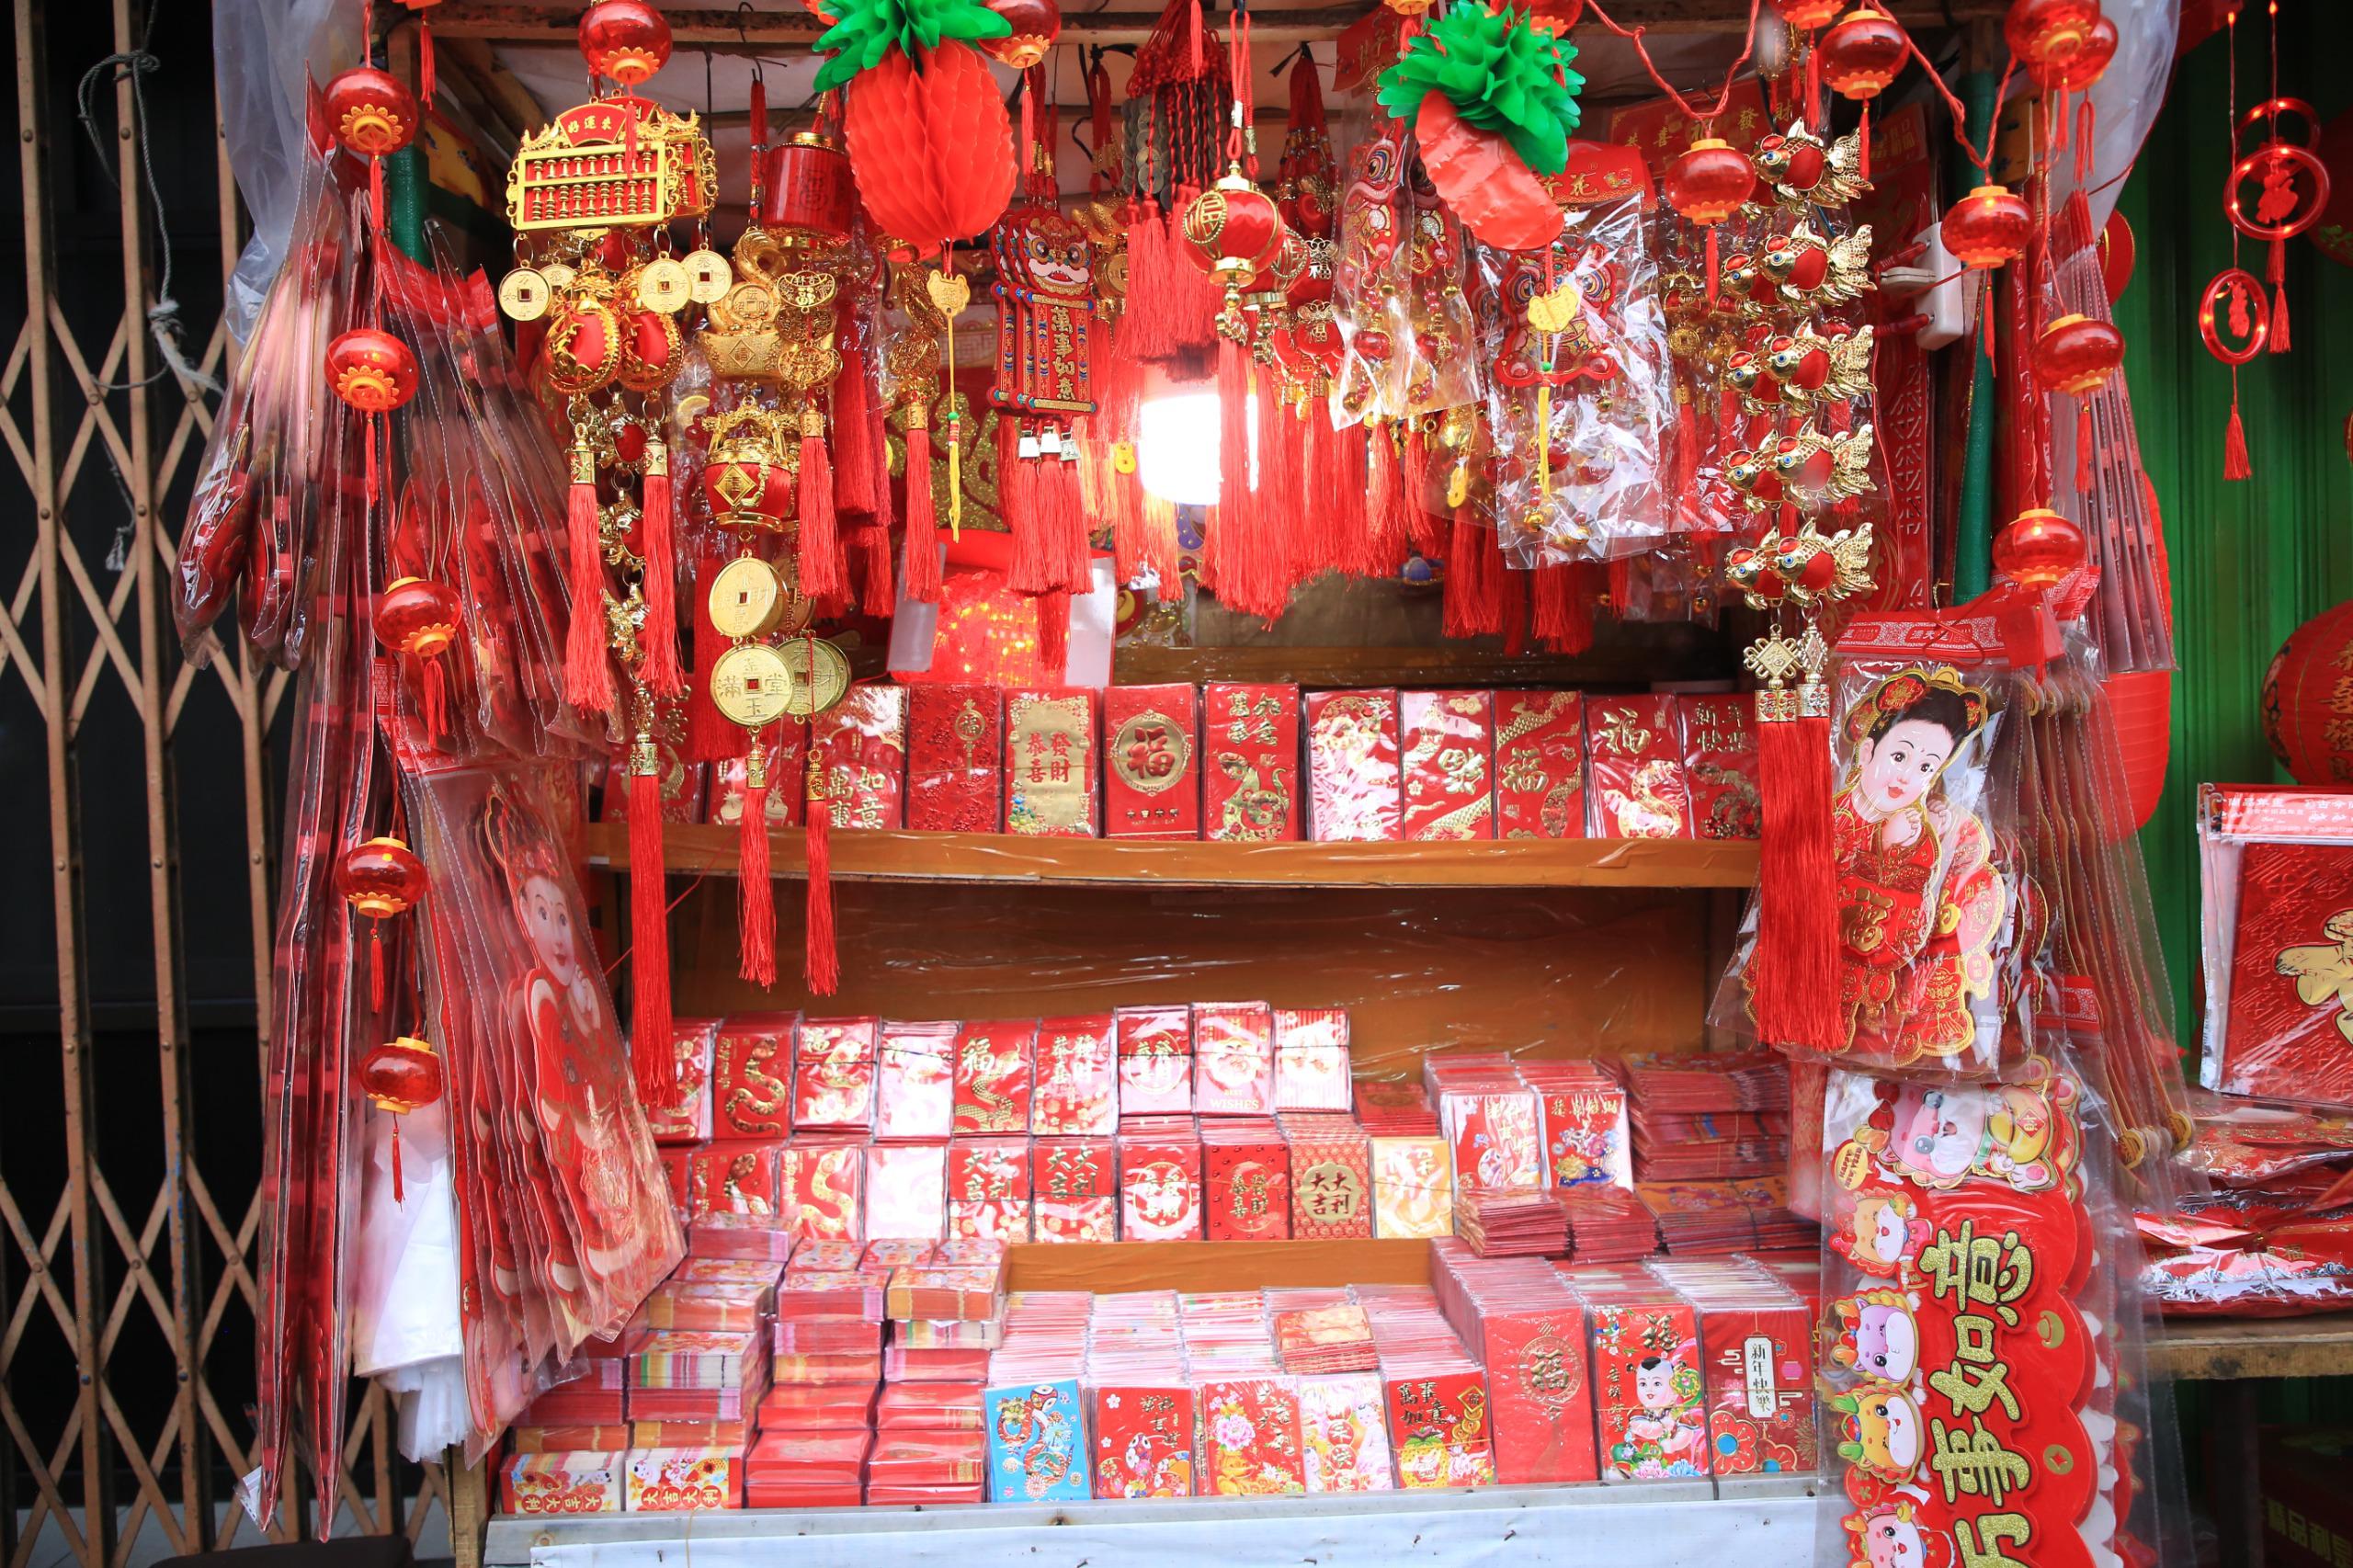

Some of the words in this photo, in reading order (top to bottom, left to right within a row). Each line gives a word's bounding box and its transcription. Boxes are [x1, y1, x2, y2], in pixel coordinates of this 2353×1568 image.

[1127, 726, 1176, 779] 福
[1598, 707, 1652, 755] 福
[1501, 746, 1549, 794] 福
[960, 1036, 996, 1085] 福
[1210, 1098, 1260, 1110] WISHES
[1839, 1149, 1851, 1177] HAPPY
[1850, 1147, 1862, 1167] YEAR
[1751, 1344, 1771, 1413] 新年快樂
[1919, 1220, 2032, 1568] 万事如意
[525, 1495, 600, 1511] 大吉大利
[643, 1488, 719, 1508] 大吉大利
